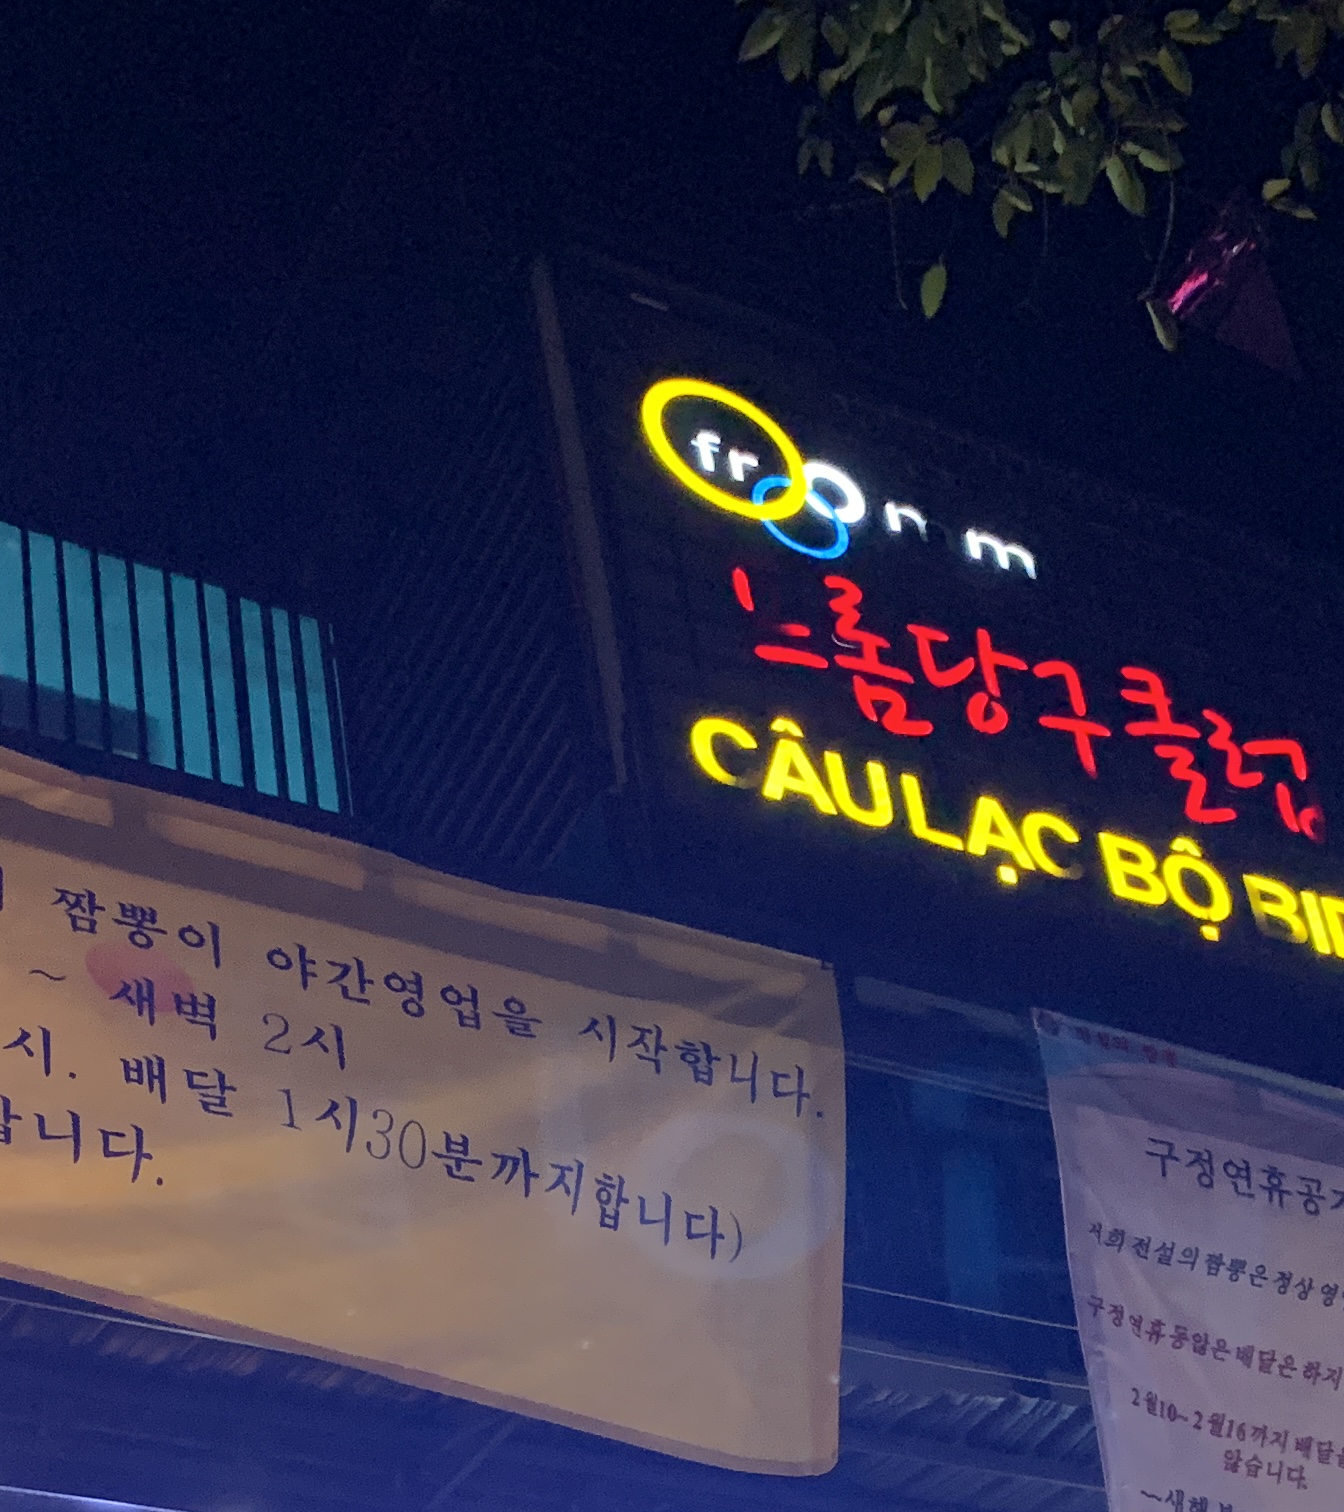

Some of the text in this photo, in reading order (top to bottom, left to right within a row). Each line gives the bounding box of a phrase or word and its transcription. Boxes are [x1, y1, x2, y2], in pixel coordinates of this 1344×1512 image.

[691, 715, 892, 828] CÂU
[901, 772, 1083, 887] LẠC
[1097, 835, 1233, 942] BỘ
[52, 885, 222, 970] 짬뽕이
[267, 942, 542, 1039] 야간영업을
[578, 1013, 825, 1119] 시작합니다.
[108, 977, 218, 1041] 새벽
[262, 1012, 348, 1071] 2시
[119, 1053, 238, 1118] 배달
[1132, 1236, 1200, 1271] 전설의
